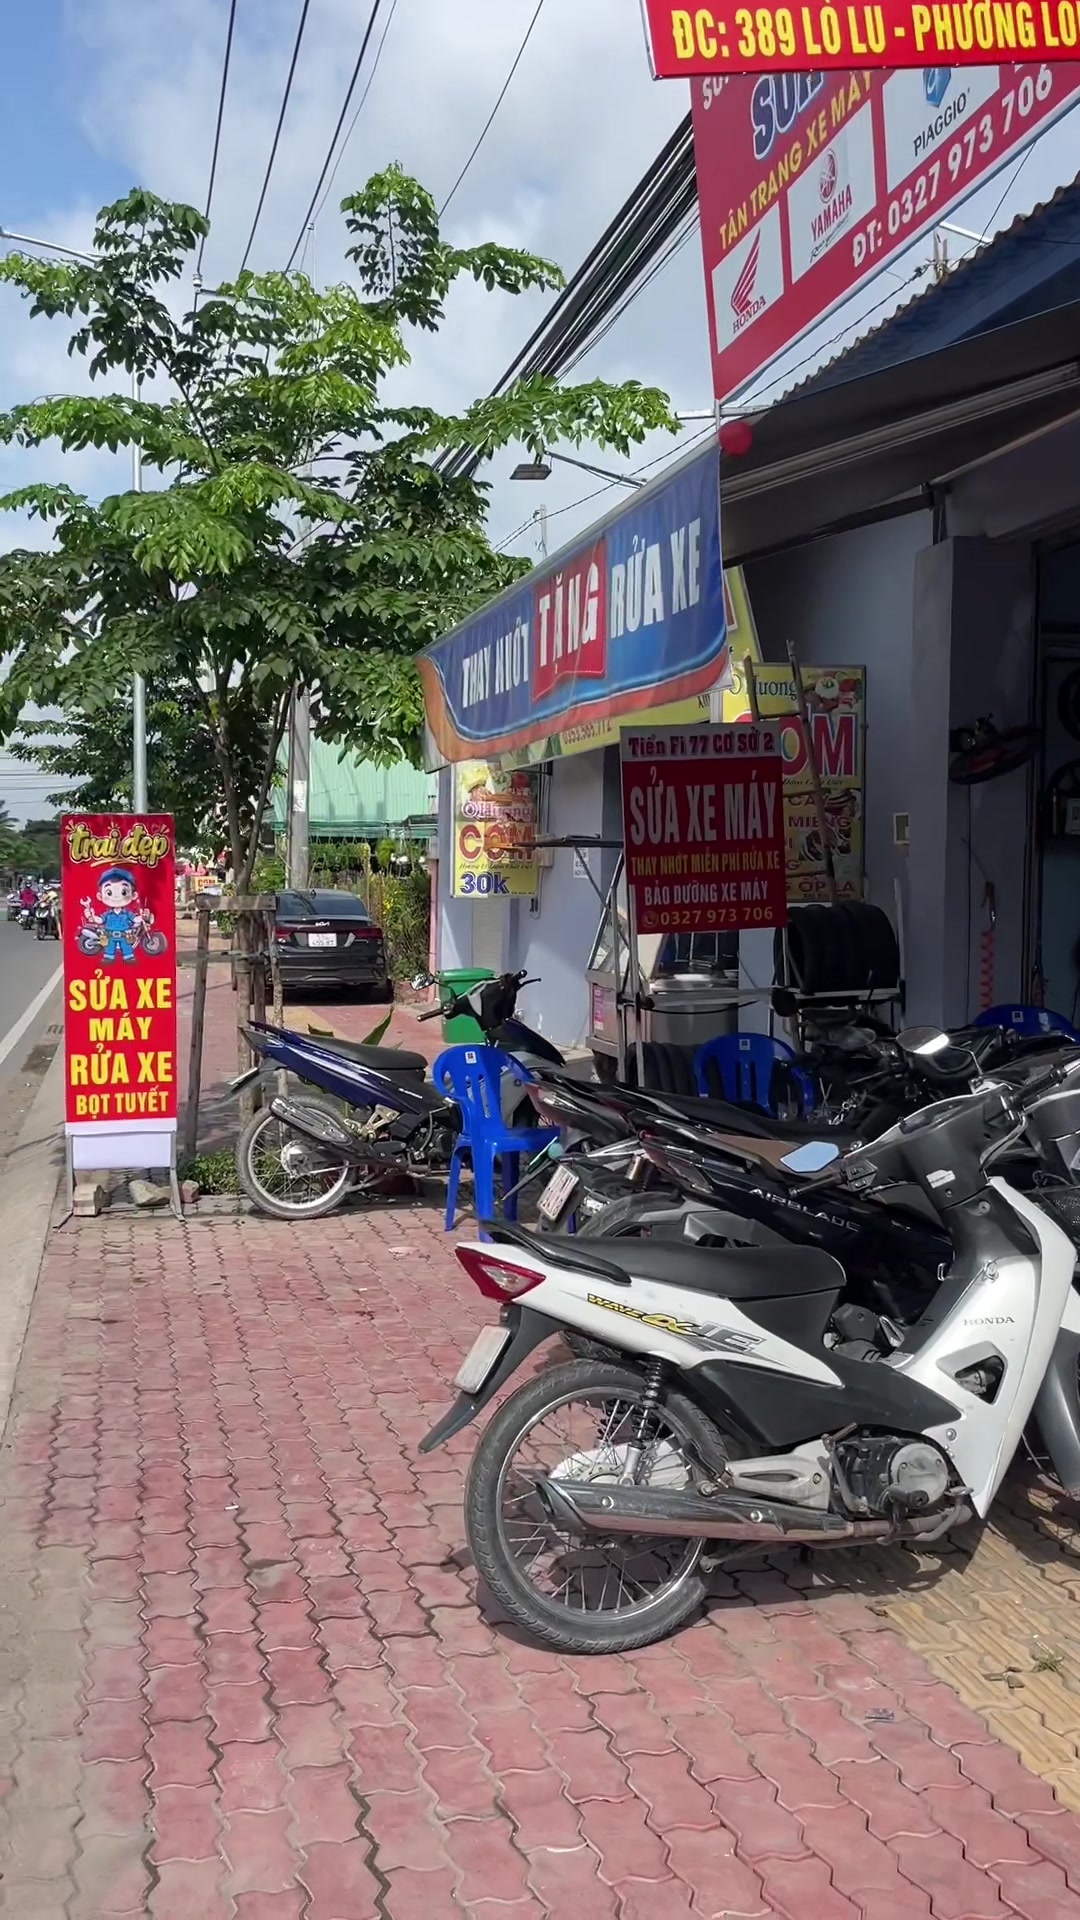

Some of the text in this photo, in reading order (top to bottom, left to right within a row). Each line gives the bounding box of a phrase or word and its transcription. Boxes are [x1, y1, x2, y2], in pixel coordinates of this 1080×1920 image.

[671, 8, 729, 58] ĐC:
[735, 8, 796, 57] 389
[801, 0, 841, 55] LÒ
[847, 5, 886, 54] LU
[1040, 0, 1080, 47] LO
[912, 93, 968, 157] PIAGGIO
[719, 202, 748, 250] TÂN
[749, 141, 803, 217] TRANG
[806, 110, 828, 156] XE
[852, 219, 882, 268] ĐT:
[888, 160, 941, 236] 0327
[947, 114, 993, 183] 973
[1001, 64, 1053, 135] 706
[811, 184, 853, 242] YAMAHA
[732, 295, 767, 335] HONDA
[462, 644, 491, 709] THAY
[538, 562, 599, 675] TẶNG
[610, 534, 665, 639] RỬA
[670, 516, 701, 615] XE
[689, 735, 709, 756] 77
[763, 732, 775, 752] 2
[629, 765, 776, 846] SỬA XE MÁY
[68, 822, 171, 868] trai đẹp
[631, 856, 658, 877] THAY
[765, 850, 781, 870] XE
[459, 870, 510, 895] 30k
[644, 879, 670, 906] BẢO
[673, 880, 718, 904] DƯỠNG
[721, 882, 738, 902] XE
[740, 877, 769, 901] MÁY
[660, 906, 773, 926] 0327 973 706
[69, 968, 172, 1011] SỬA XE
[89, 1012, 152, 1041] MÁY
[70, 1042, 173, 1086] RỬA XE
[76, 1085, 169, 1119] BỌT TUYẾT
[963, 1315, 1015, 1326] HONDA
